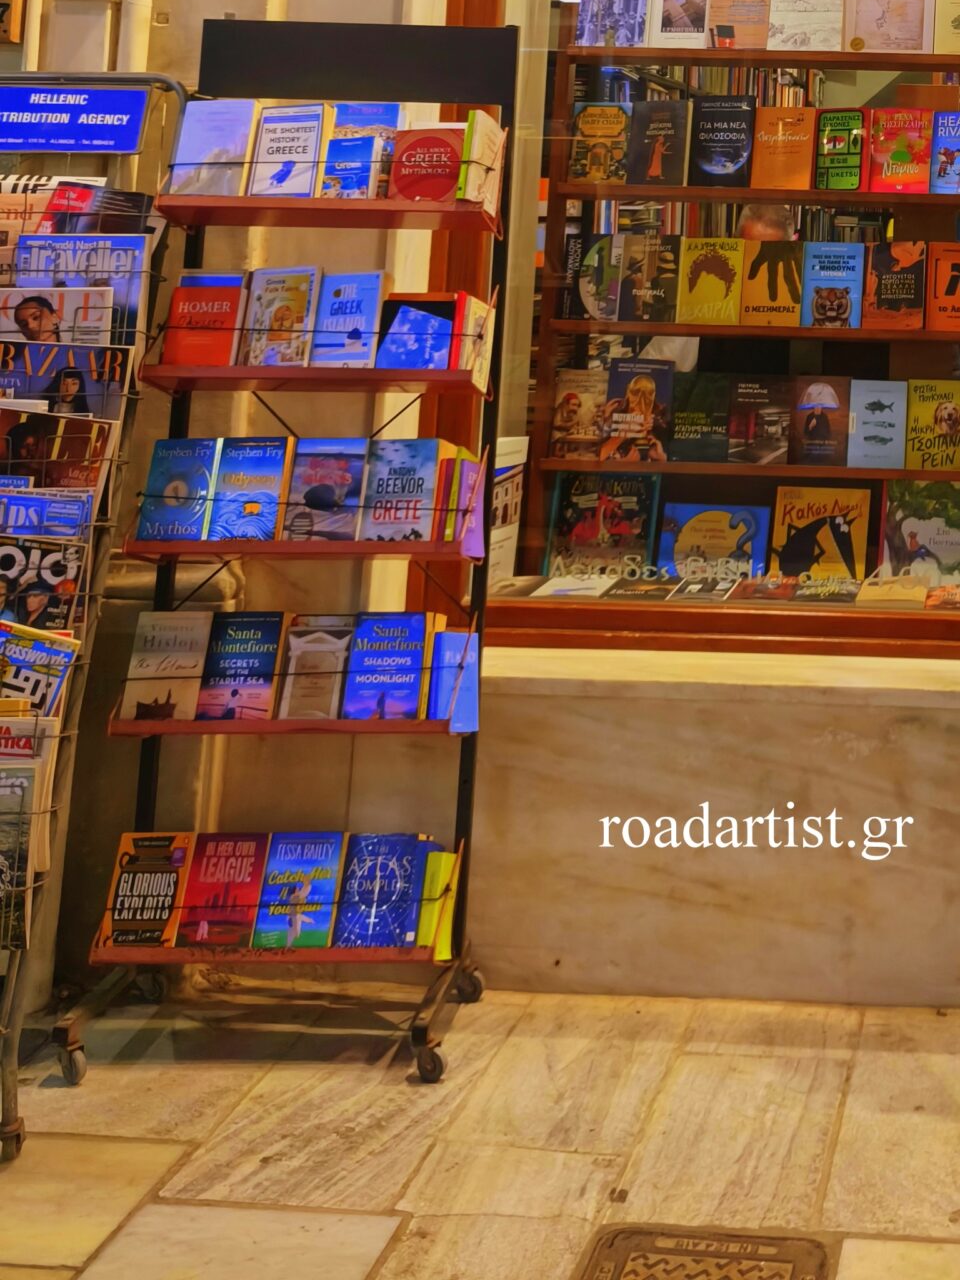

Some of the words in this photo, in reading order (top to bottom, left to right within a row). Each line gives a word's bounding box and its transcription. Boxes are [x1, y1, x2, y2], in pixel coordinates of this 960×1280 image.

[30, 93, 89, 105] HELLENIC
[78, 113, 130, 125] AGENCY
[699, 121, 712, 129] ΓΙΑ
[713, 121, 728, 129] ΜΙΑ
[729, 121, 747, 129] ΝΕΑ
[264, 127, 279, 135] THE
[280, 125, 317, 135] SHORTEST
[698, 132, 746, 141] ΦΙΛΟΣΟΦΙΑ
[269, 136, 301, 145] HISTORY
[266, 145, 309, 156] GREECE
[402, 150, 452, 167] GREEK
[400, 167, 451, 176] MYTHOLOGY
[830, 170, 859, 178] UKETSU
[46, 240, 74, 250] Condé
[75, 240, 99, 250] Nast
[26, 240, 139, 280] Traveller
[178, 301, 231, 313] HOMER
[330, 298, 363, 317] GREEK
[0, 342, 123, 382] BAZAAR
[712, 425, 727, 433] ΜΑΣ
[910, 423, 936, 436] ΜΙΚΡΗ
[156, 446, 188, 459] Stephen
[190, 446, 213, 460] Fry
[226, 446, 263, 459] Stephen
[265, 446, 284, 461] Fry
[921, 450, 956, 469] ΡΕΪΝ
[387, 467, 417, 477] ANTONY
[376, 477, 424, 495] BEEVOR
[371, 499, 422, 521] CRETE
[782, 501, 828, 526] Κακός
[143, 521, 198, 539] Mythos
[226, 626, 262, 640] Santa
[372, 624, 409, 637] Santa
[143, 635, 199, 652] Hislop
[209, 641, 278, 654] Montefiore
[354, 638, 424, 652] Montefiore
[219, 659, 260, 668] SECRETS
[363, 657, 412, 666] SHADOWS
[209, 677, 245, 685] STARLIT
[246, 677, 265, 685] SEA
[355, 674, 416, 684] MOONLIGHT
[206, 840, 216, 855] IN
[217, 840, 234, 855] HER
[303, 843, 335, 860] BAILEY
[199, 857, 254, 884] LEAGUE
[347, 855, 412, 877] ATLAS
[119, 872, 178, 896] GLORIOUS
[268, 869, 305, 886] Catch
[113, 896, 172, 920] EXPLOITS
[268, 903, 290, 916] You
